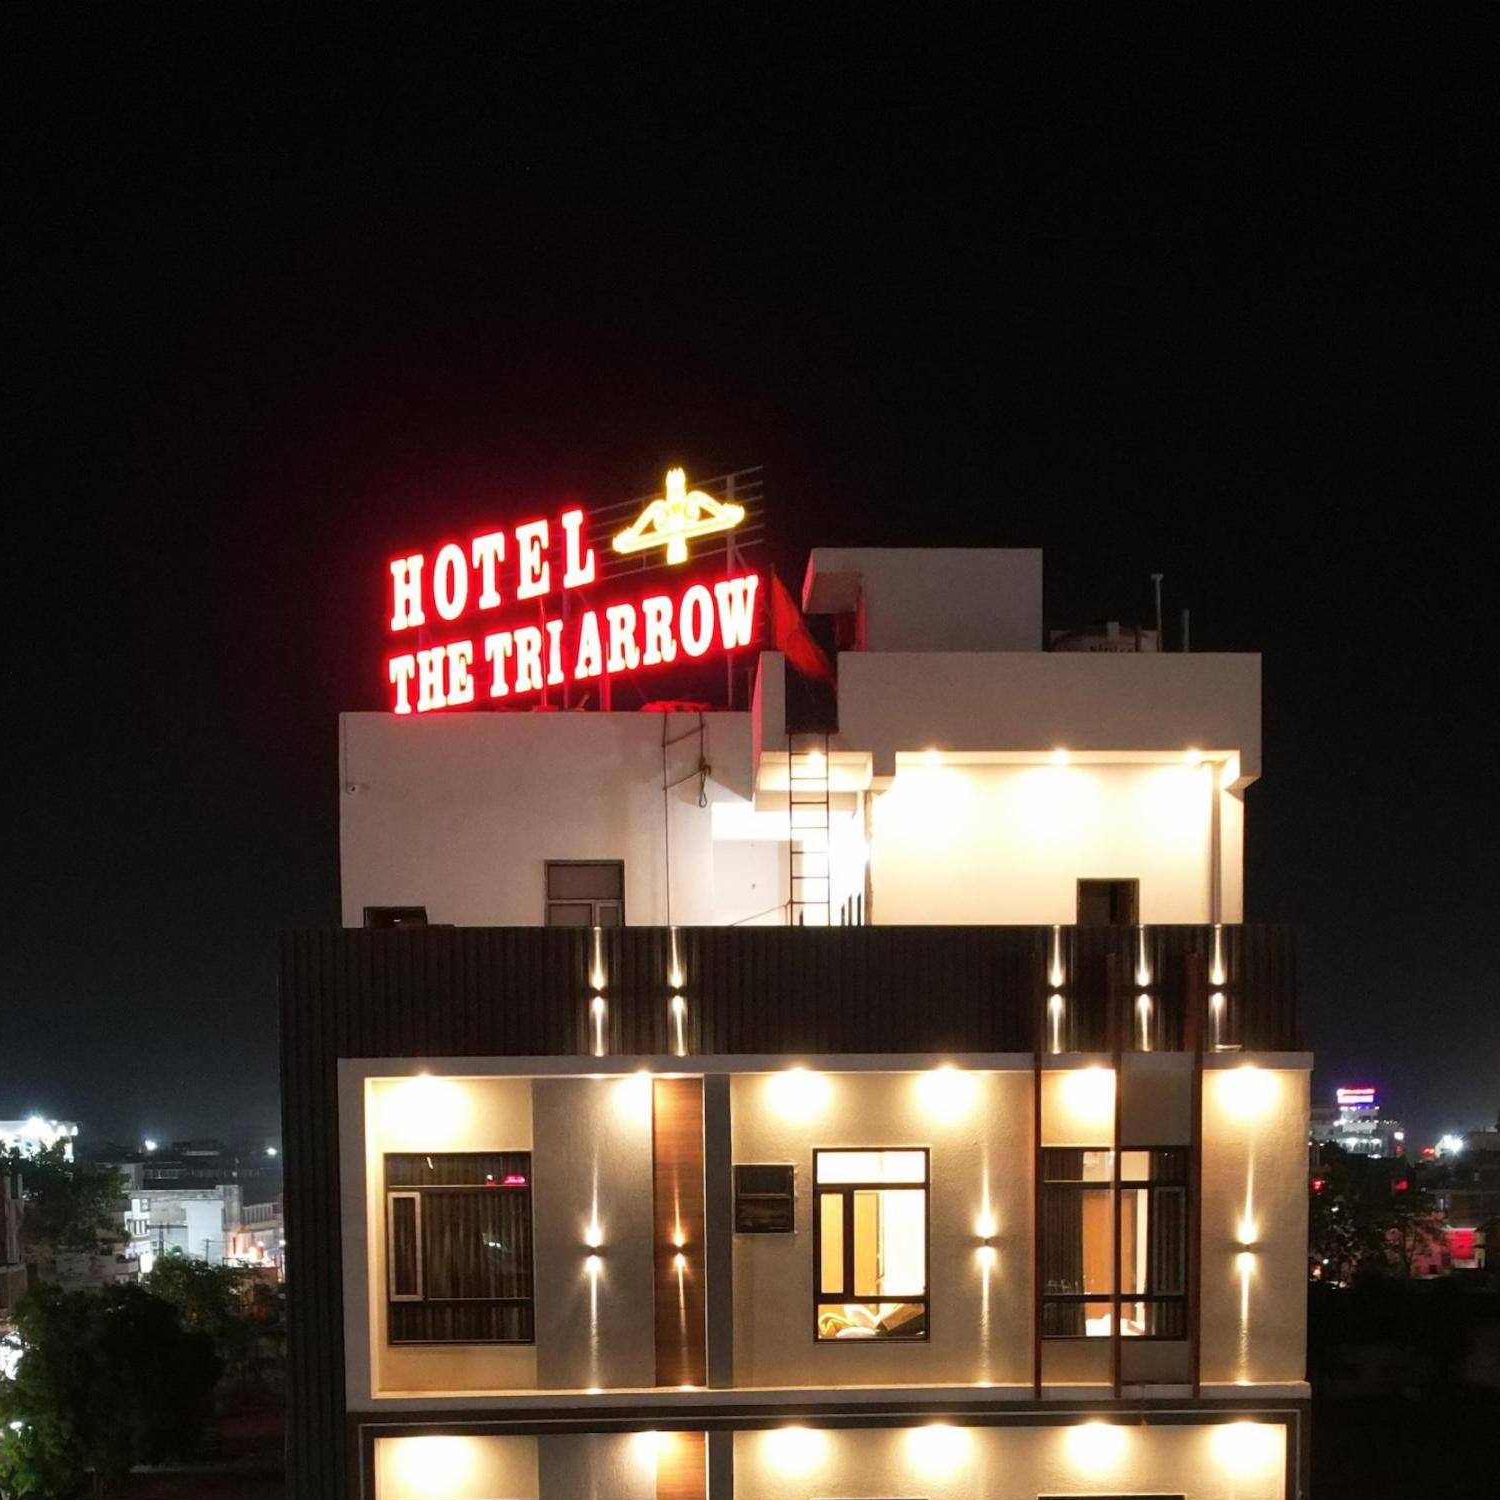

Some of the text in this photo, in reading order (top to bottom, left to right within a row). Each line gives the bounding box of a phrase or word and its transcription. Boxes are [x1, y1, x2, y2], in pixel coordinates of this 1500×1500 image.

[389, 508, 596, 632] HOTEL
[388, 574, 759, 715] THE TRI ARROW
